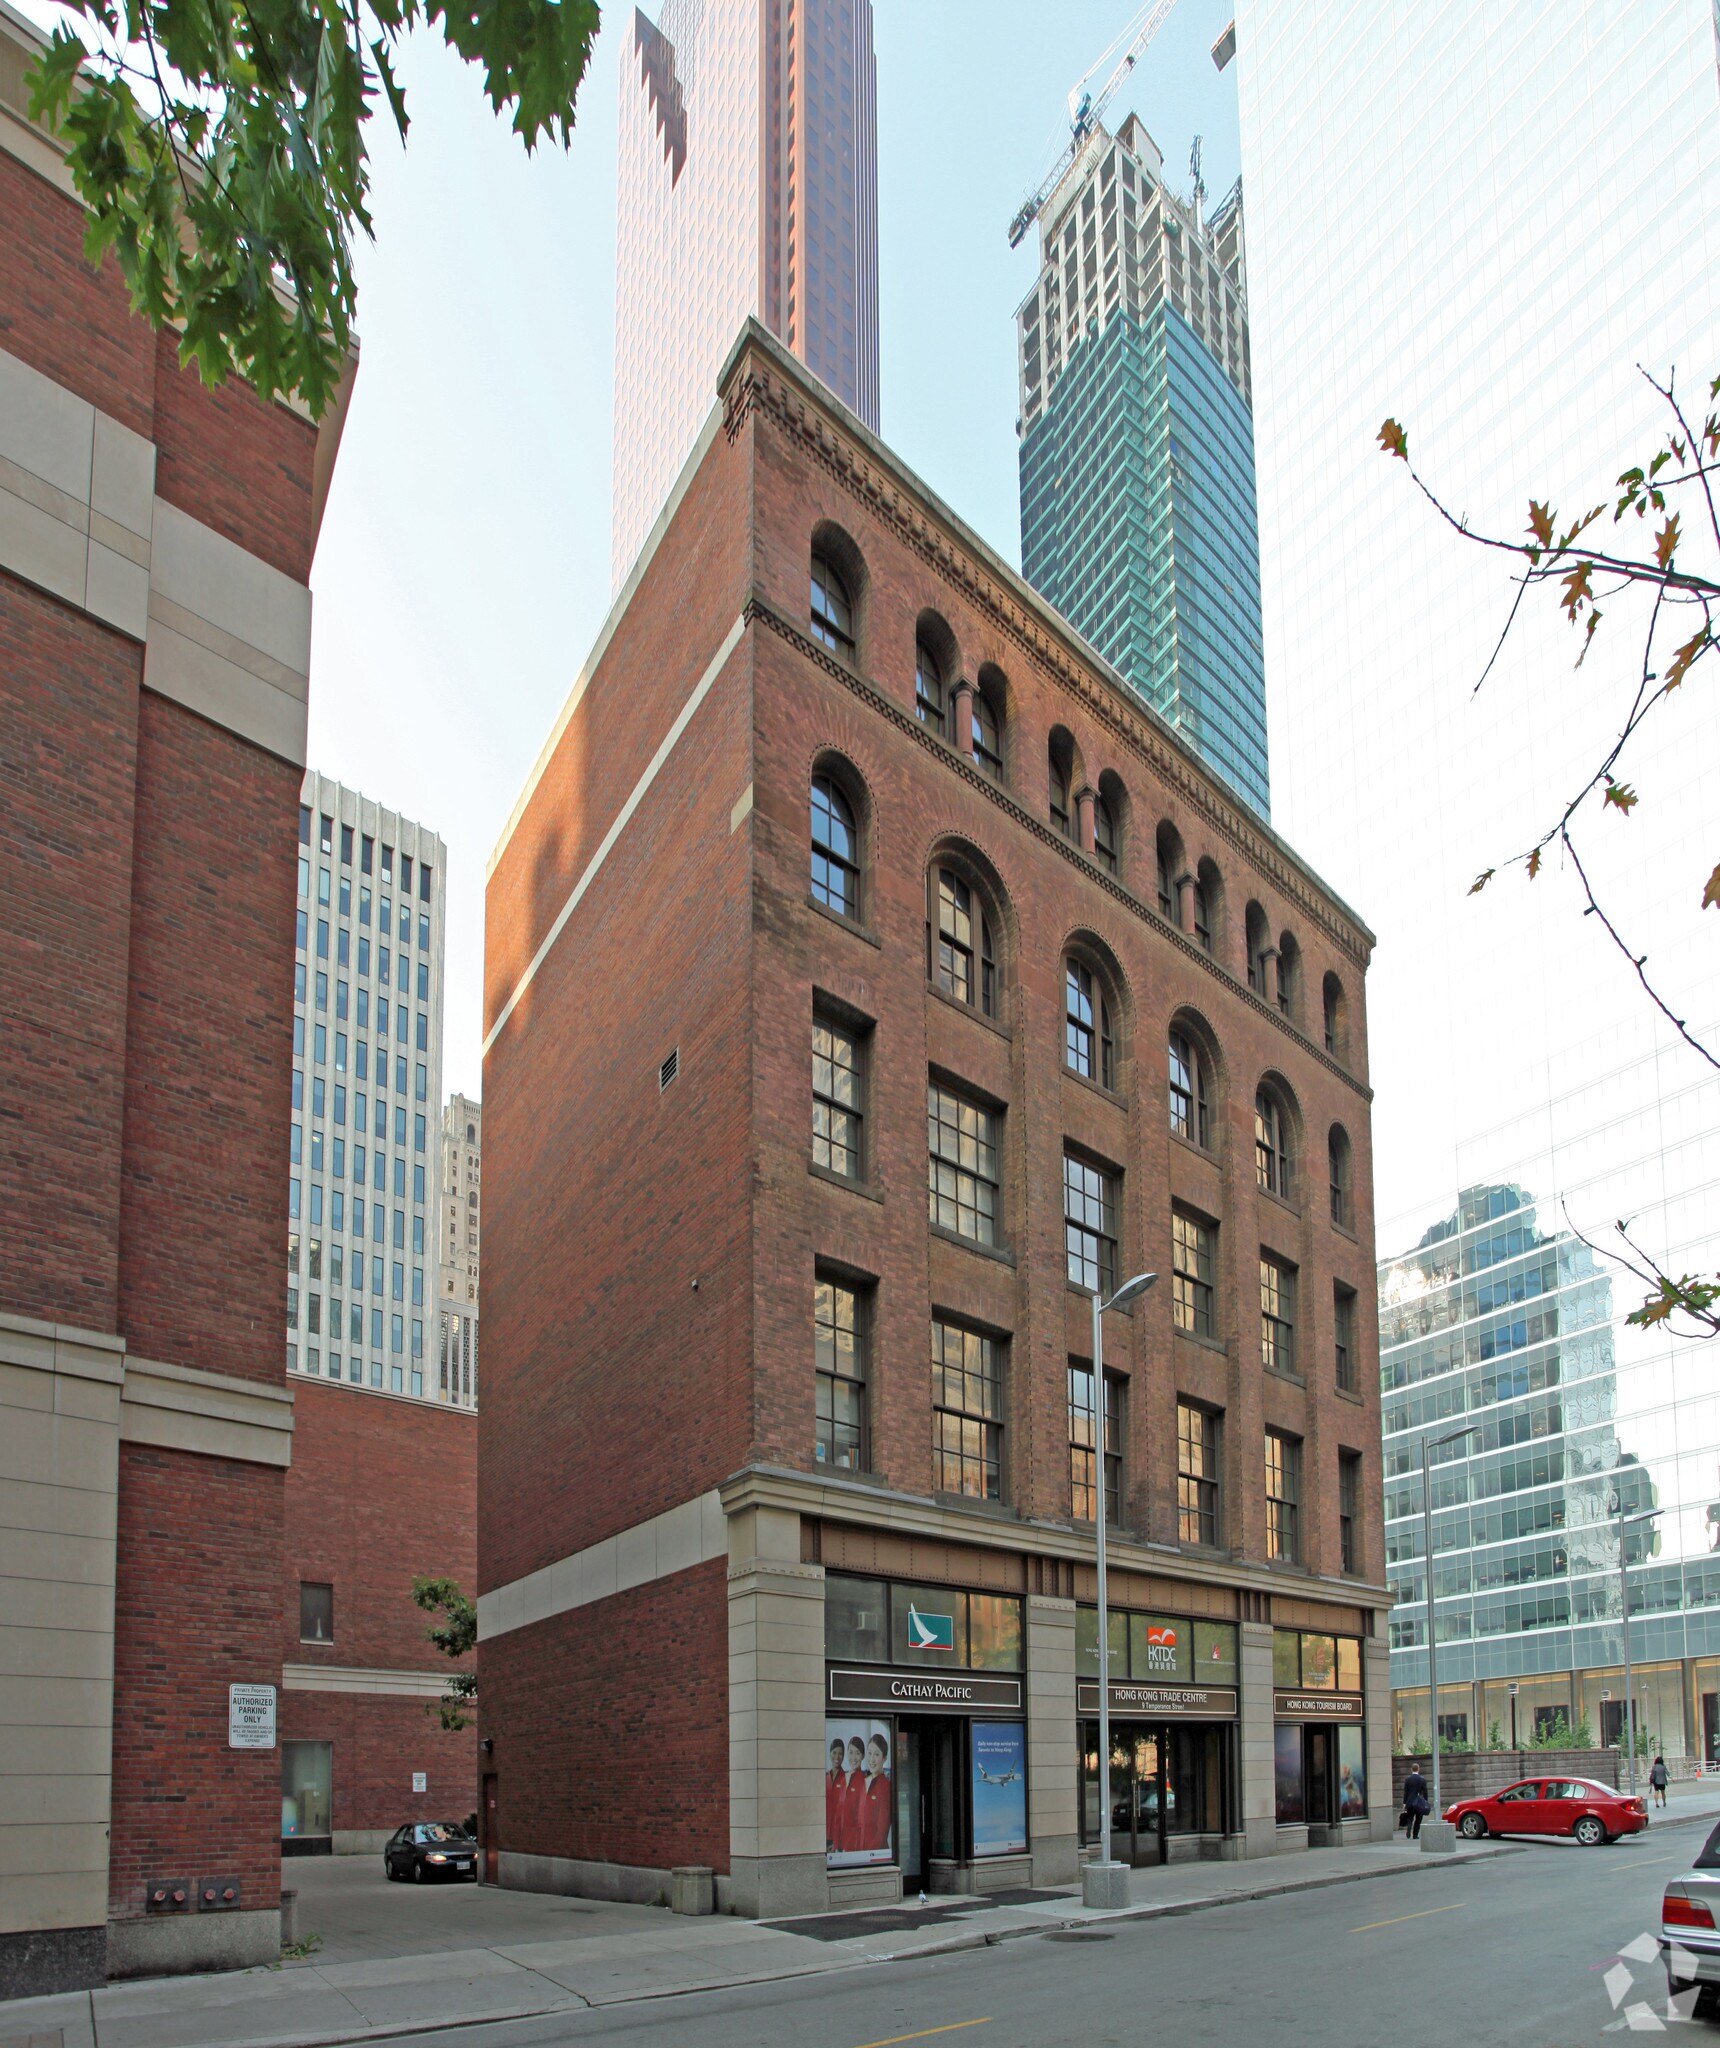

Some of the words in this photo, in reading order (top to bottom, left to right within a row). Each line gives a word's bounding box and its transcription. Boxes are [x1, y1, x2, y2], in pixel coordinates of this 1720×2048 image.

[1148, 1645, 1176, 1662] HKTDC
[891, 1681, 933, 1697] CATHAY
[935, 1684, 972, 1699] PACIFIC
[233, 1697, 273, 1706] AUTHORIZED
[1115, 1689, 1136, 1701] HONG
[1137, 1690, 1158, 1702] KONG
[1159, 1691, 1181, 1703] TRADE
[1182, 1692, 1207, 1704] CENTRE
[238, 1707, 267, 1715] PARKING
[1146, 1702, 1171, 1711] Temperance
[1172, 1703, 1185, 1711] Street
[1286, 1700, 1301, 1710] HONG
[1302, 1701, 1316, 1710] KONG
[1316, 1701, 1336, 1711] TOURISM
[1337, 1702, 1353, 1711] BOARD
